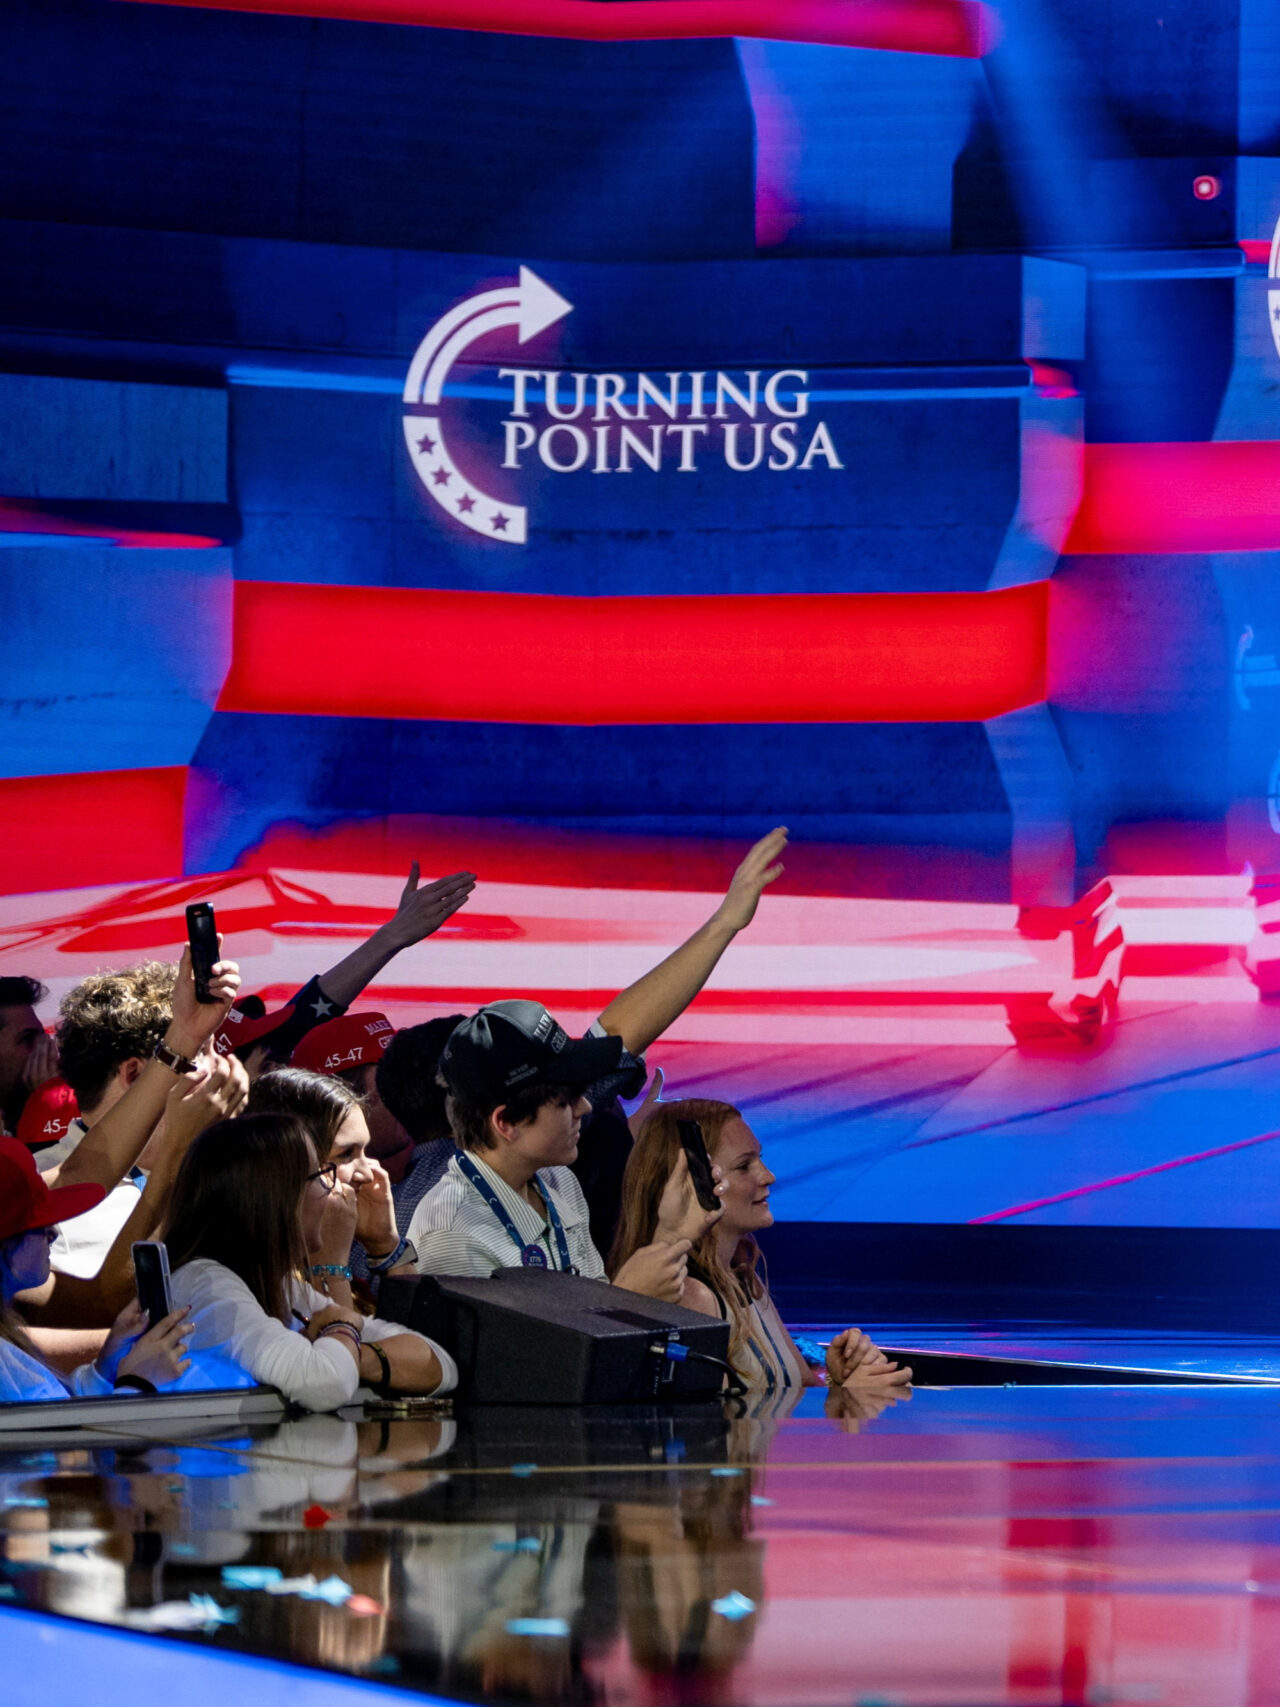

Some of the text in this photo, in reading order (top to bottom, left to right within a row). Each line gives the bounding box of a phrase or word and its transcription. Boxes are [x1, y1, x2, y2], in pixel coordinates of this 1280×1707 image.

[498, 368, 811, 422] TURNING
[501, 420, 845, 473] POINT USA
